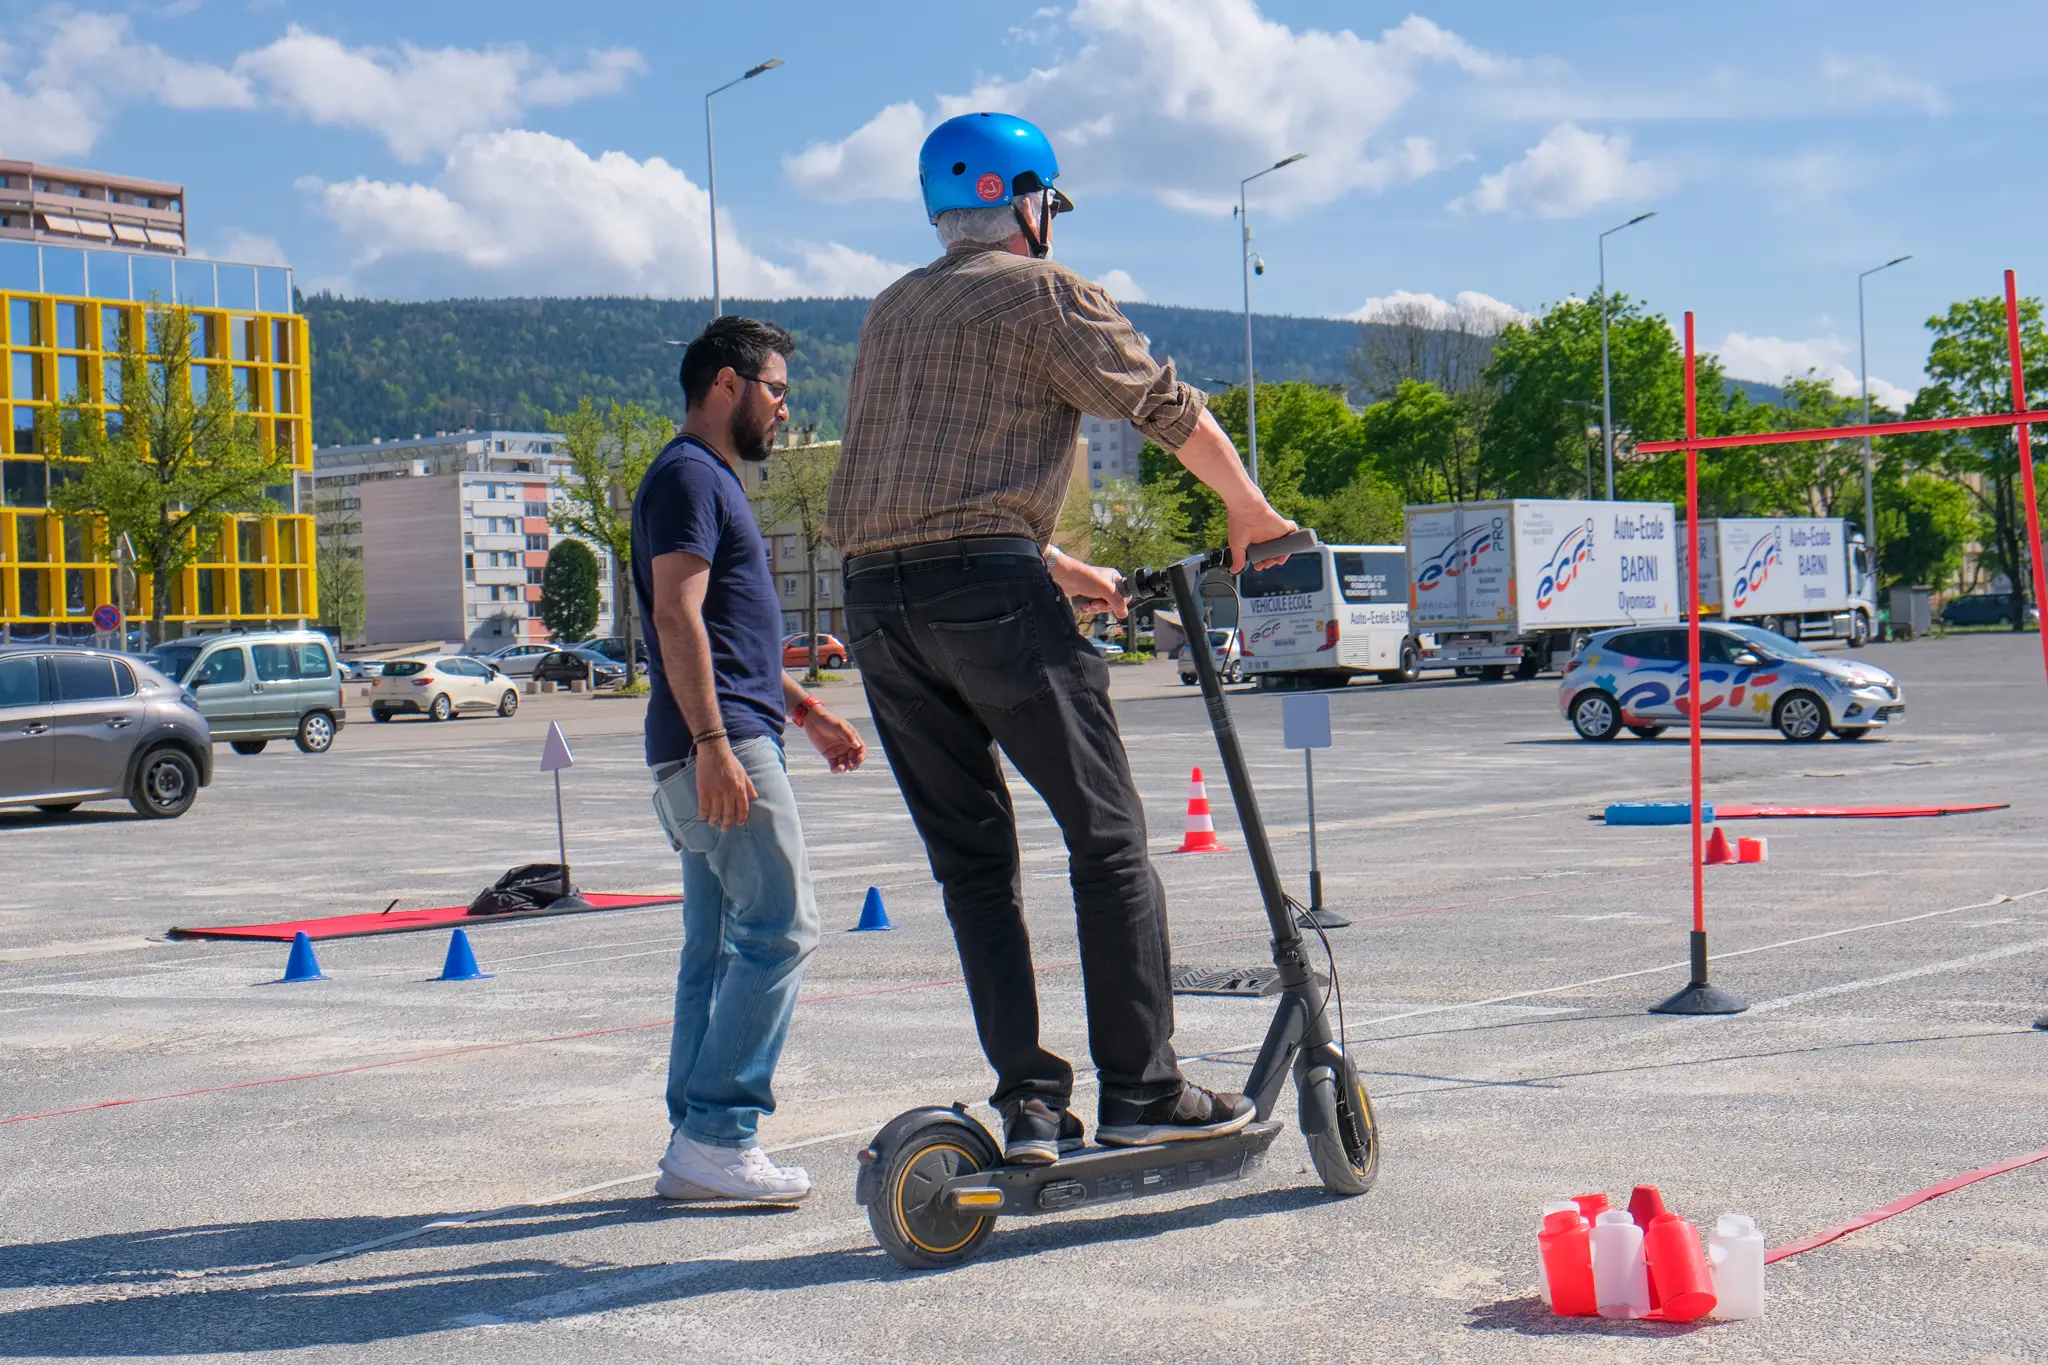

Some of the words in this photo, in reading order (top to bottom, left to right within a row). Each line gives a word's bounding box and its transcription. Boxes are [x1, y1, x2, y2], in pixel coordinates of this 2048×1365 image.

[1492, 516, 1504, 552] PRO
[1614, 514, 1665, 540] Auto-Ecole
[1789, 526, 1831, 547] Auto-Ecole
[1585, 517, 1596, 562] PRO
[1620, 555, 1658, 582] BARNI
[1798, 555, 1828, 576] BARNI
[1251, 597, 1287, 613] VEHICULE
[1288, 595, 1312, 610] ECOLE
[1618, 591, 1656, 611] Oyonnax
[1351, 611, 1390, 625] Auto-Ecole
